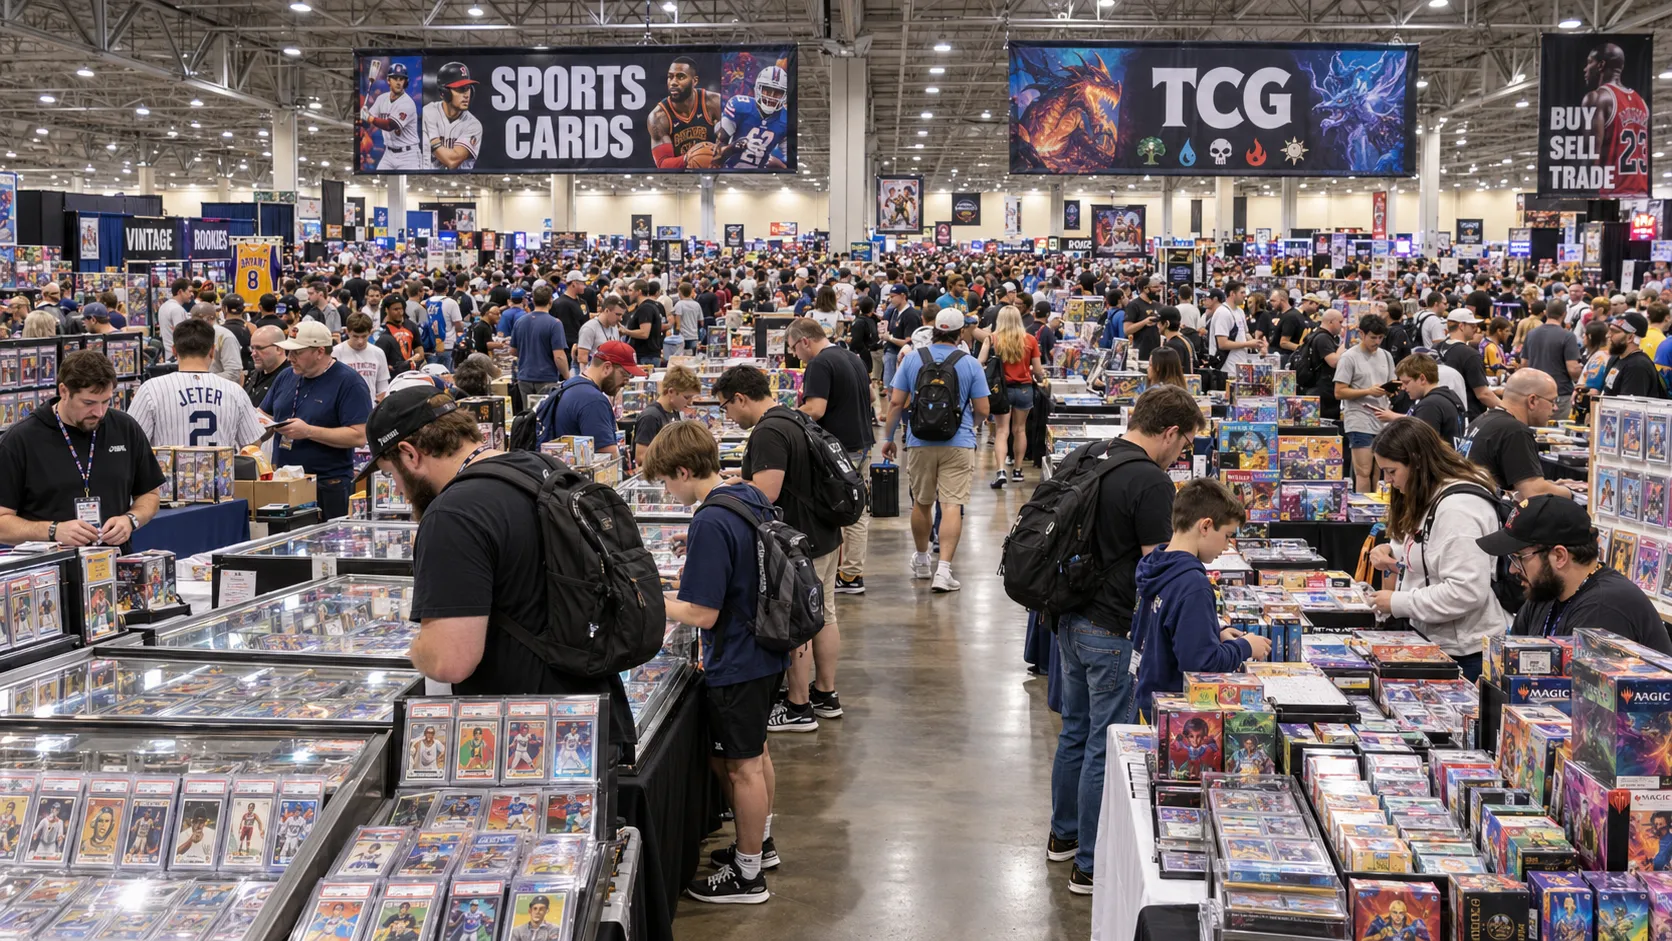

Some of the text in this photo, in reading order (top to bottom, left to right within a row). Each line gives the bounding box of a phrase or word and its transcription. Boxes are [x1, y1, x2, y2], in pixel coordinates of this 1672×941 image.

[491, 65, 646, 111] SPORTS
[1152, 66, 1292, 130] TCG
[1550, 106, 1597, 131] BUY
[505, 115, 634, 160] CARDS
[1549, 135, 1600, 160] SELL
[1549, 165, 1616, 190] TRADE
[125, 227, 173, 251] VINTAGE
[194, 229, 228, 251] ROOKIES
[247, 269, 259, 291] 8
[178, 387, 223, 407] JETER
[189, 410, 217, 446] 2
[1529, 688, 1570, 698] MAGIC
